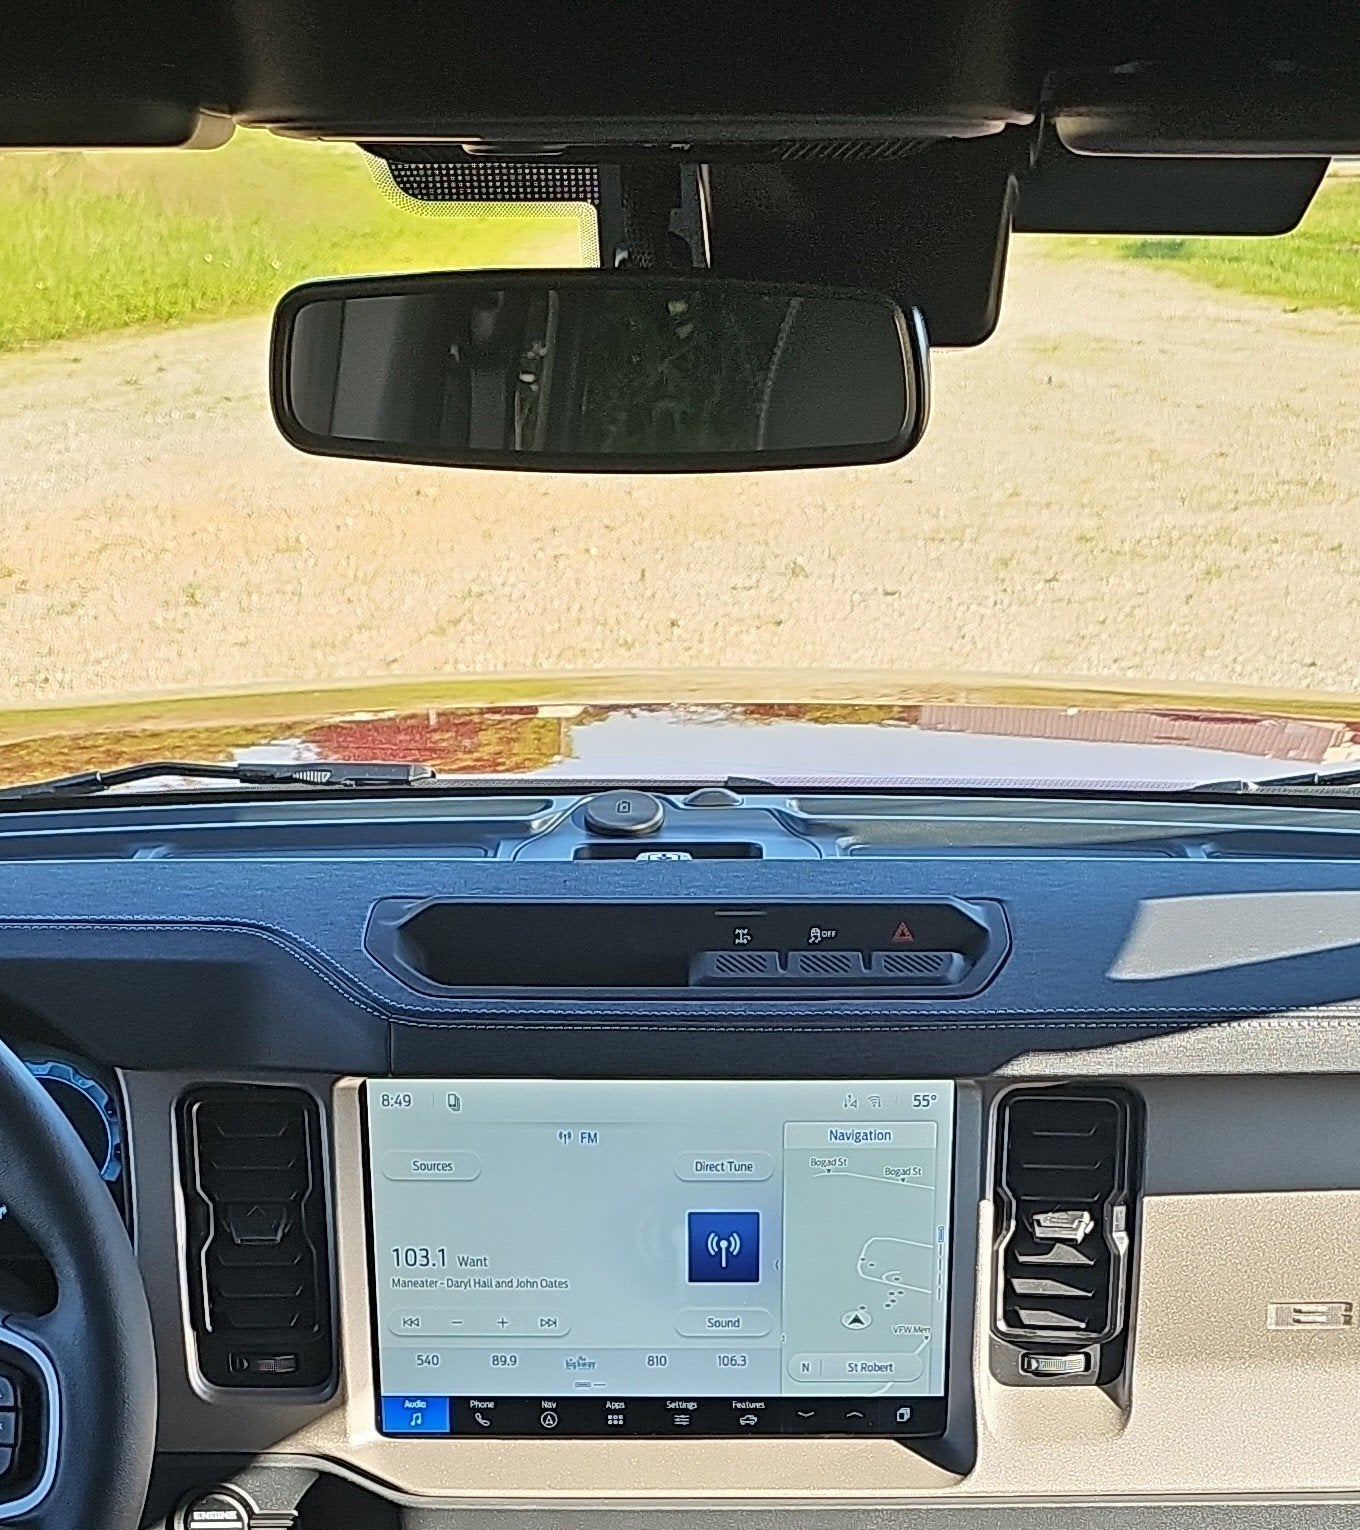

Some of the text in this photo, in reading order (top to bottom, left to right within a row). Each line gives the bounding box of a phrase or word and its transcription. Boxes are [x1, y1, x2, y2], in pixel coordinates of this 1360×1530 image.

[821, 930, 837, 938] OFF
[381, 1093, 412, 1108] 8:49
[912, 1094, 938, 1108] 55°
[580, 1131, 599, 1145] FM
[828, 1129, 892, 1144] Navigation
[412, 1160, 454, 1172] Sources
[694, 1160, 754, 1172] Direct Tune
[810, 1157, 848, 1168] Bogad St
[884, 1166, 922, 1177] Bogad St
[391, 1247, 489, 1268] 103.1 Want
[391, 1278, 439, 1289] Maneater
[446, 1278, 472, 1290] Daryl
[473, 1278, 493, 1289] Hall
[494, 1278, 514, 1289] and
[515, 1278, 539, 1289] John
[539, 1278, 570, 1289] Oates
[706, 1317, 741, 1329] Sound
[893, 1326, 913, 1334] VFW
[416, 1354, 440, 1367] 540
[491, 1355, 518, 1367] 89.9
[646, 1355, 667, 1367] 810
[717, 1355, 747, 1367] 106.3
[801, 1362, 810, 1373] N
[847, 1362, 894, 1373] St Robert
[404, 1400, 427, 1408] Audio
[469, 1400, 495, 1409] Phone
[541, 1400, 557, 1408] Nav
[605, 1400, 626, 1409] Apps
[666, 1400, 698, 1410] Settings
[732, 1400, 765, 1409] Features
